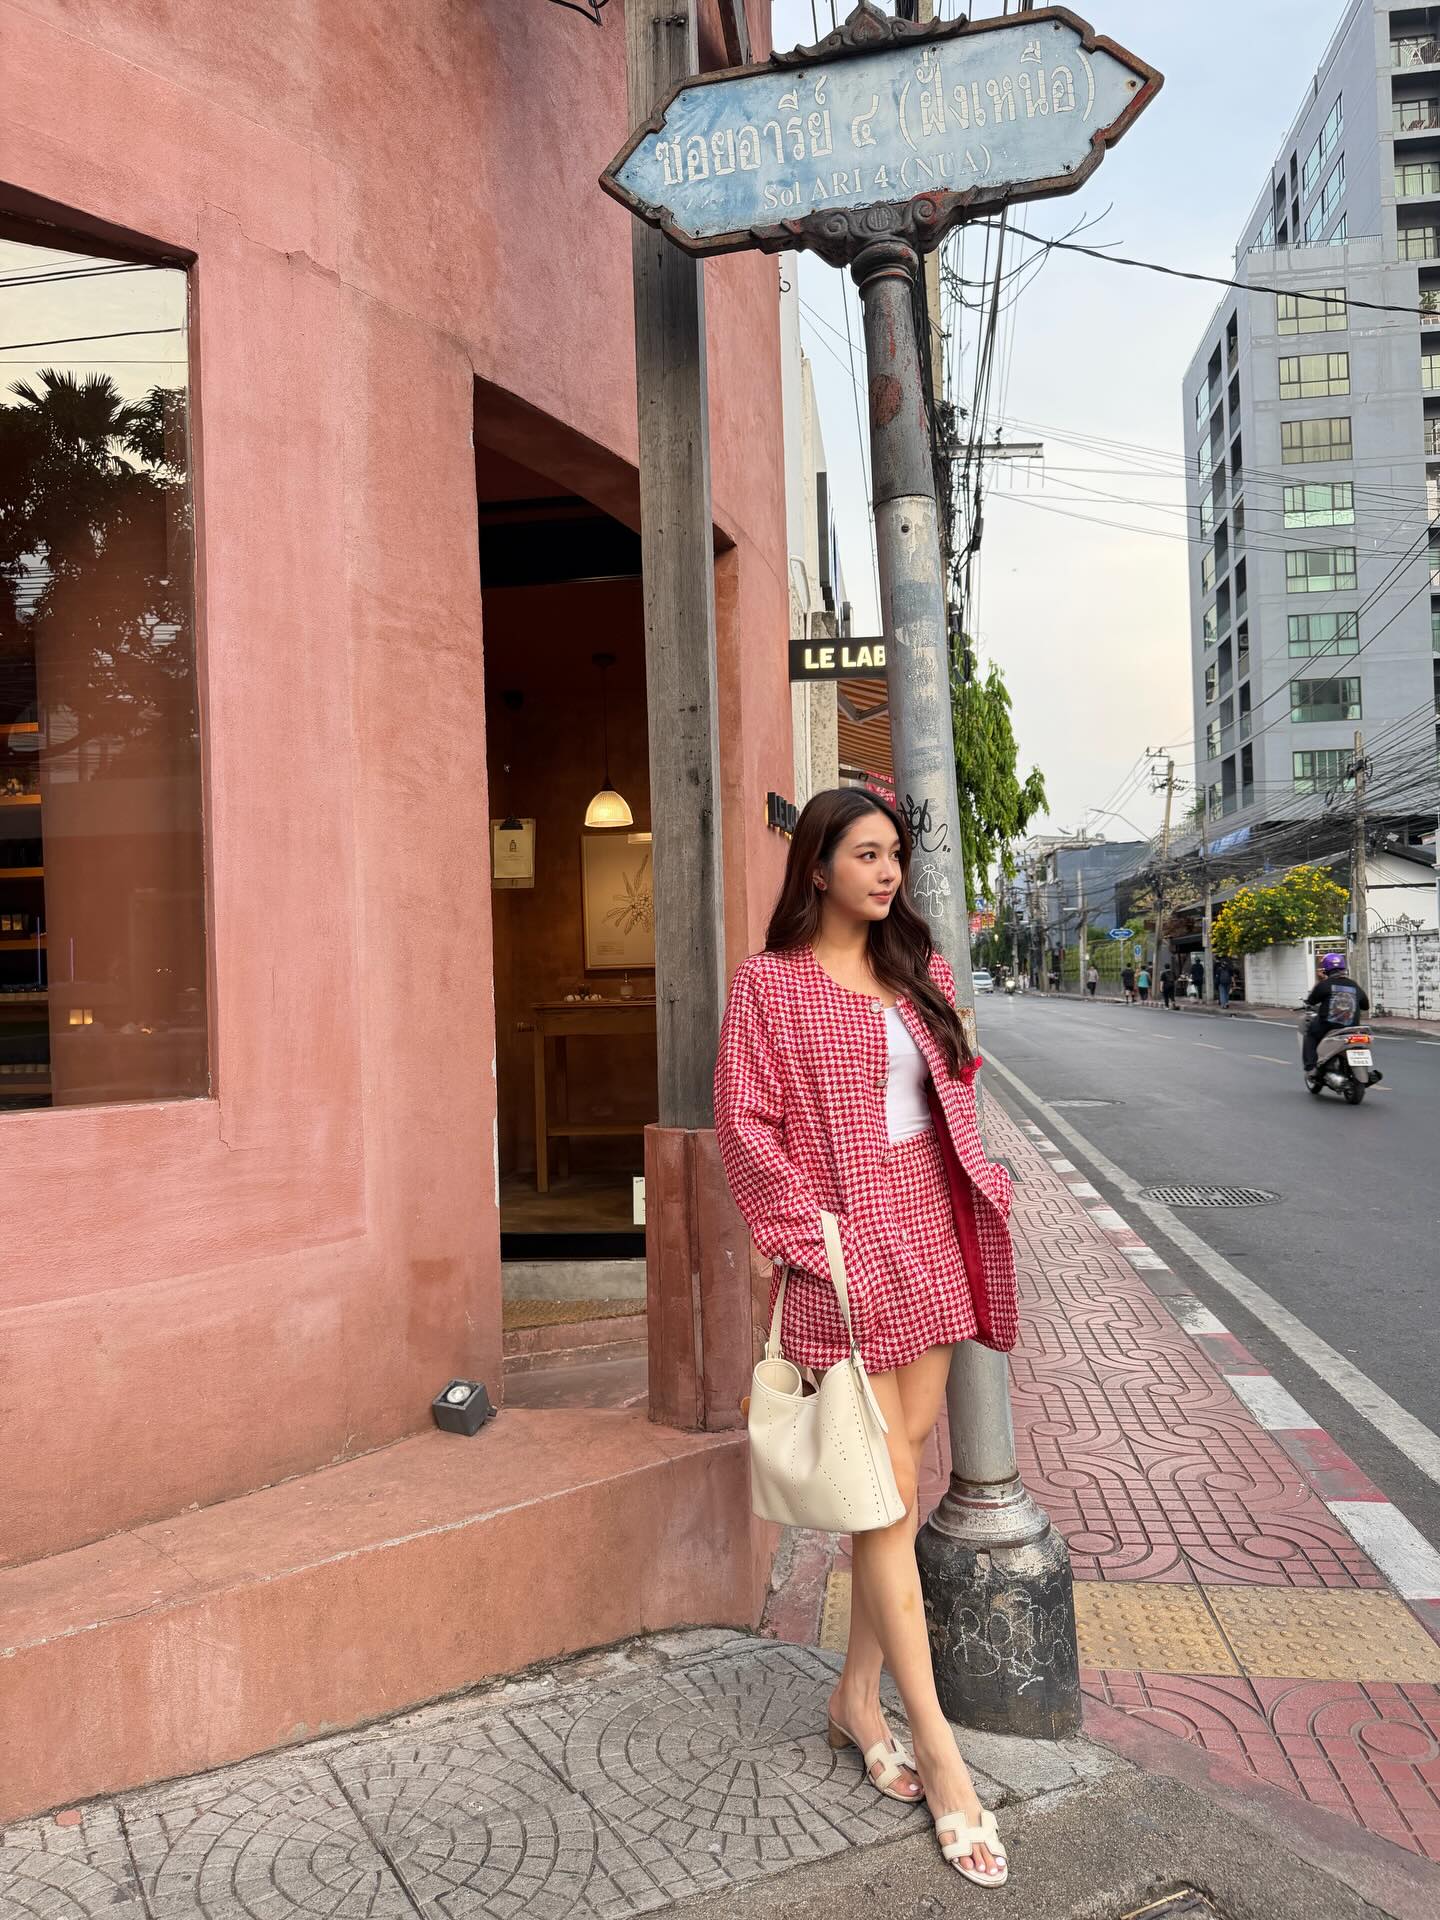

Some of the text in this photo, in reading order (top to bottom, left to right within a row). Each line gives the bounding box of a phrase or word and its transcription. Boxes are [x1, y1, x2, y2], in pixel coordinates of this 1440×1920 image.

[655, 39, 1096, 186] ซอยอารีย์ ๔ (ฝั่งเหนือ)
[811, 167, 864, 200] ARI
[873, 164, 889, 188] 4
[900, 144, 992, 189] (NUA)
[804, 647, 836, 669] LE
